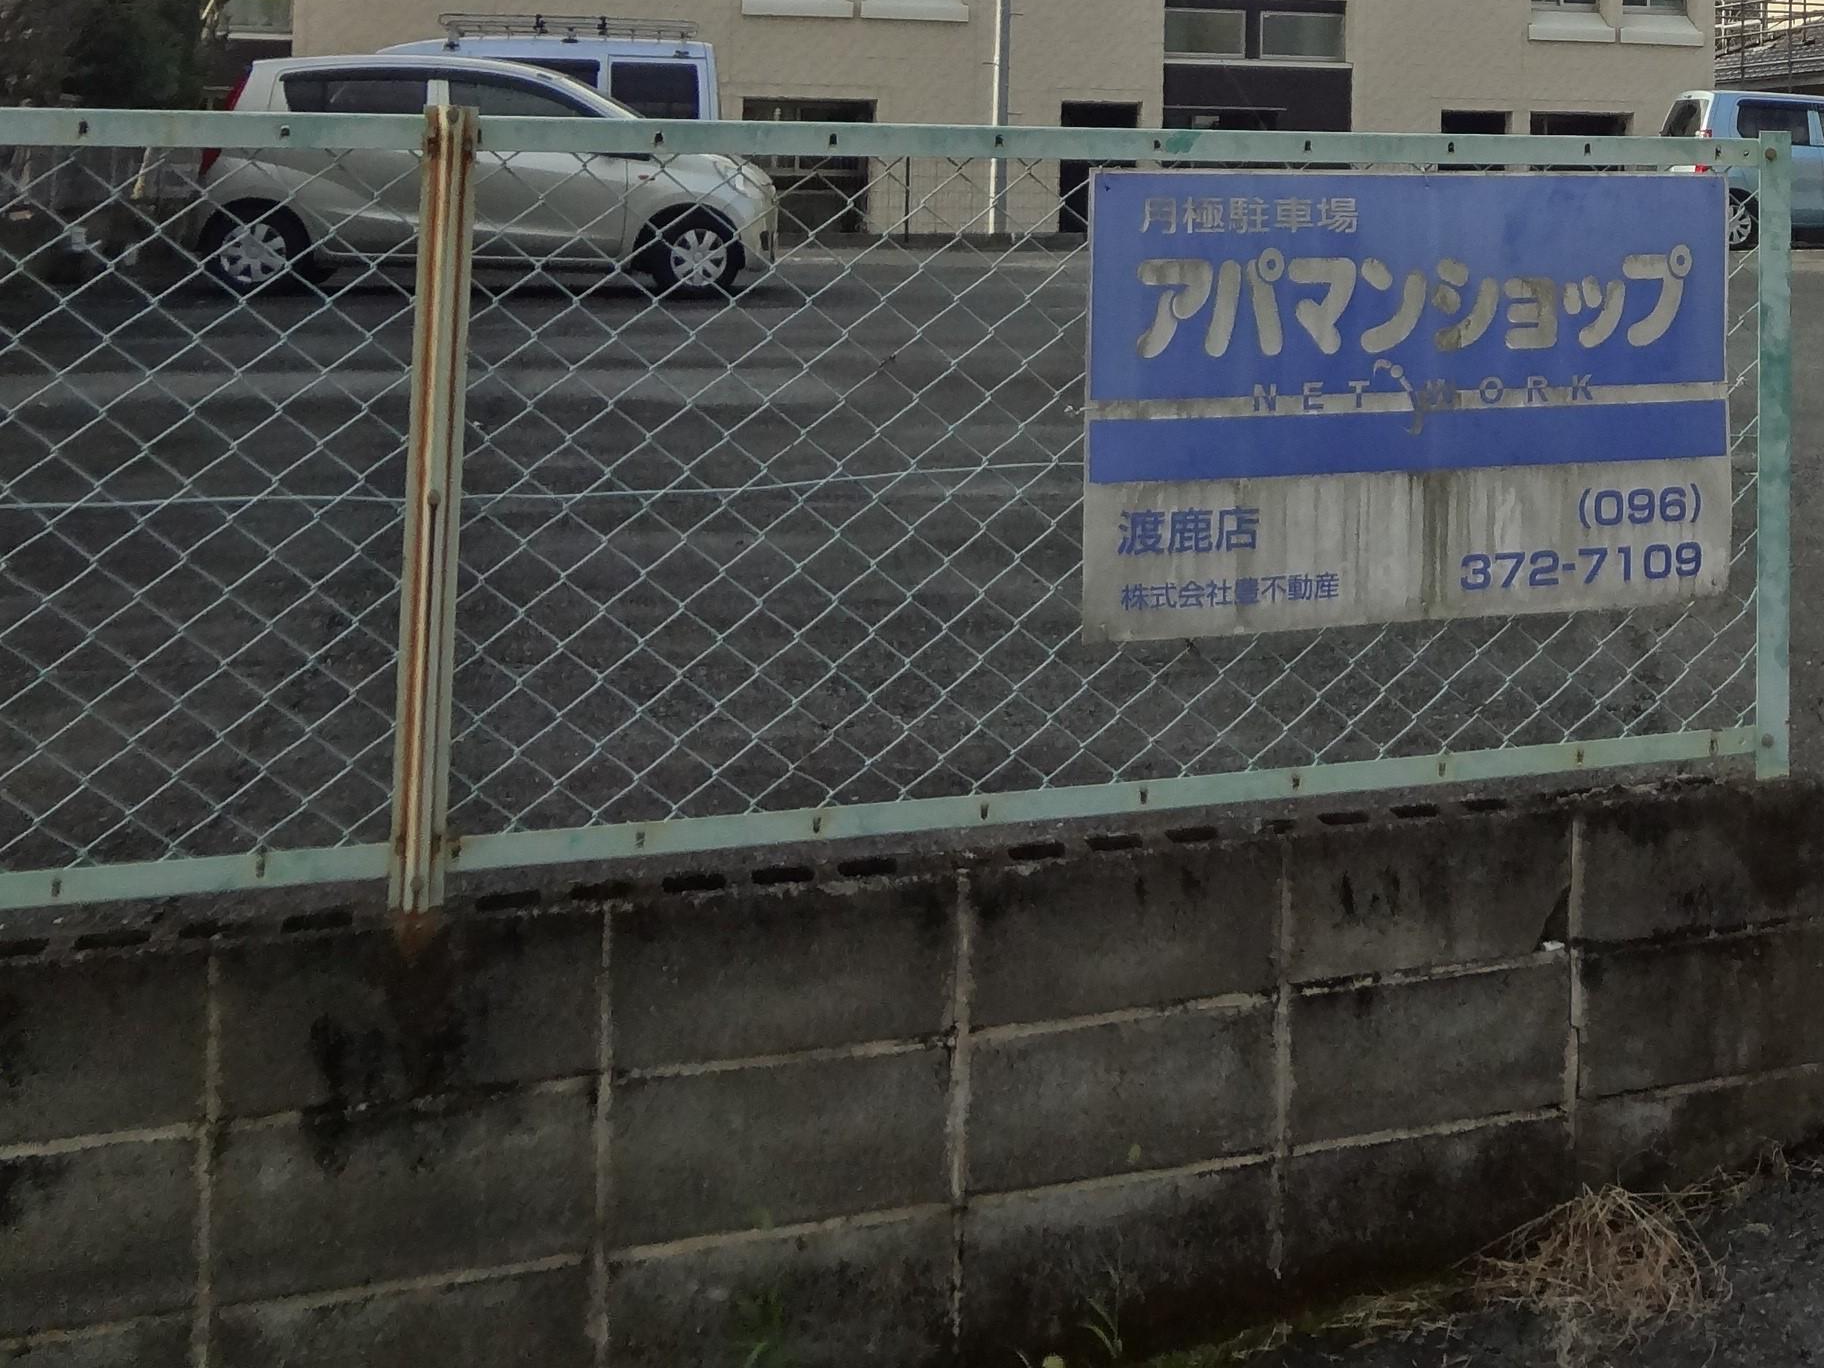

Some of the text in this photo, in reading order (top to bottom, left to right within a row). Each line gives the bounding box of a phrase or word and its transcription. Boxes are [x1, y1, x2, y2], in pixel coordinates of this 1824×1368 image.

[1139, 196, 1359, 234] 月極駐車場
[1137, 244, 1694, 359] アパマンショップ
[1117, 505, 1260, 556] 渡鹿店
[1579, 483, 1701, 529] (096)
[1460, 541, 1703, 591] 372-7109
